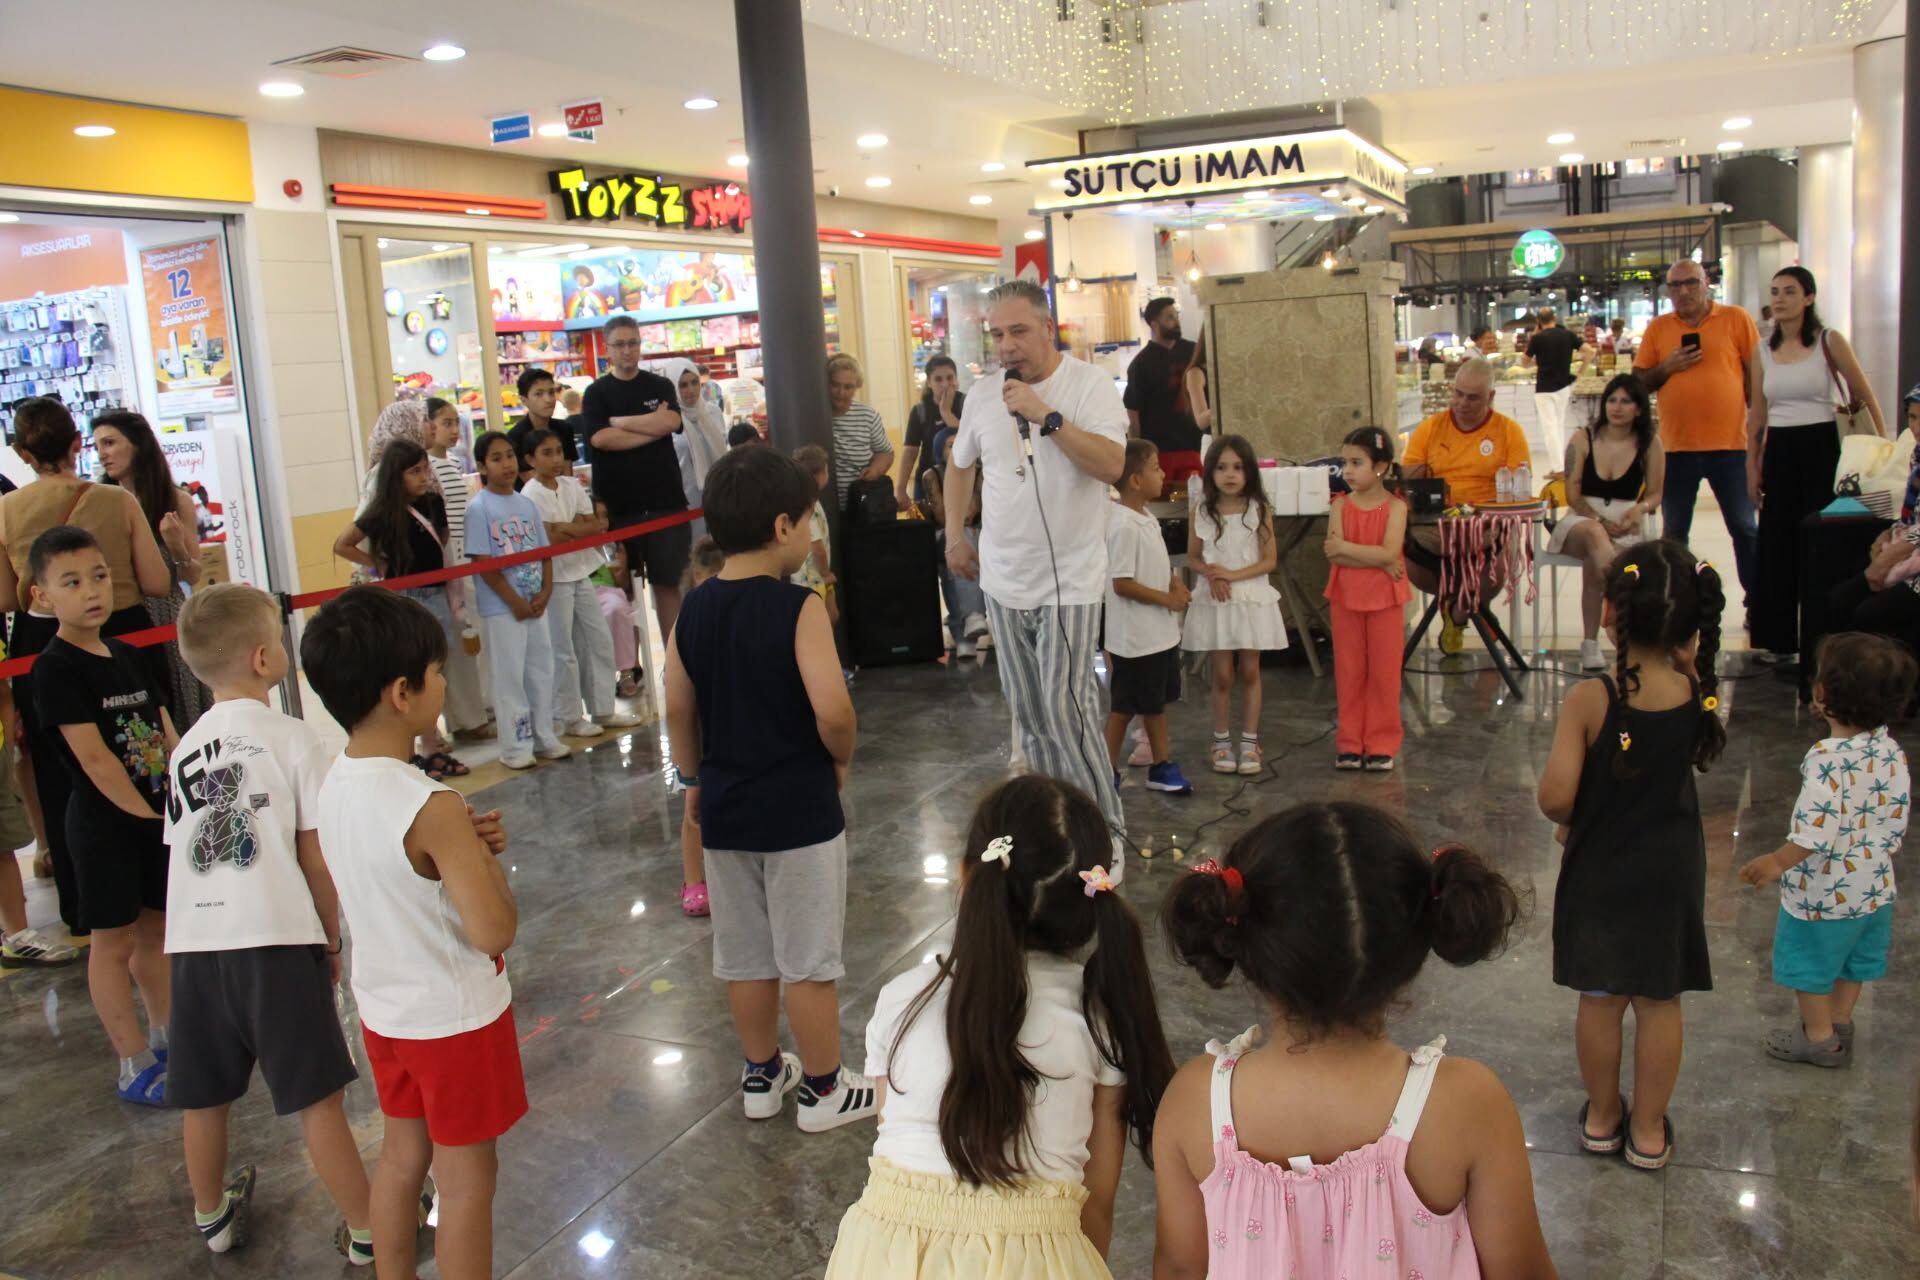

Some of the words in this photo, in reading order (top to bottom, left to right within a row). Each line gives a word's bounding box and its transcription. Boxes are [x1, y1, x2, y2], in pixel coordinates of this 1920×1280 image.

[1064, 156, 1181, 197] SÜTÇÜ
[1195, 143, 1305, 184] İMAM
[167, 268, 192, 299] 12
[229, 500, 247, 579] roborock
